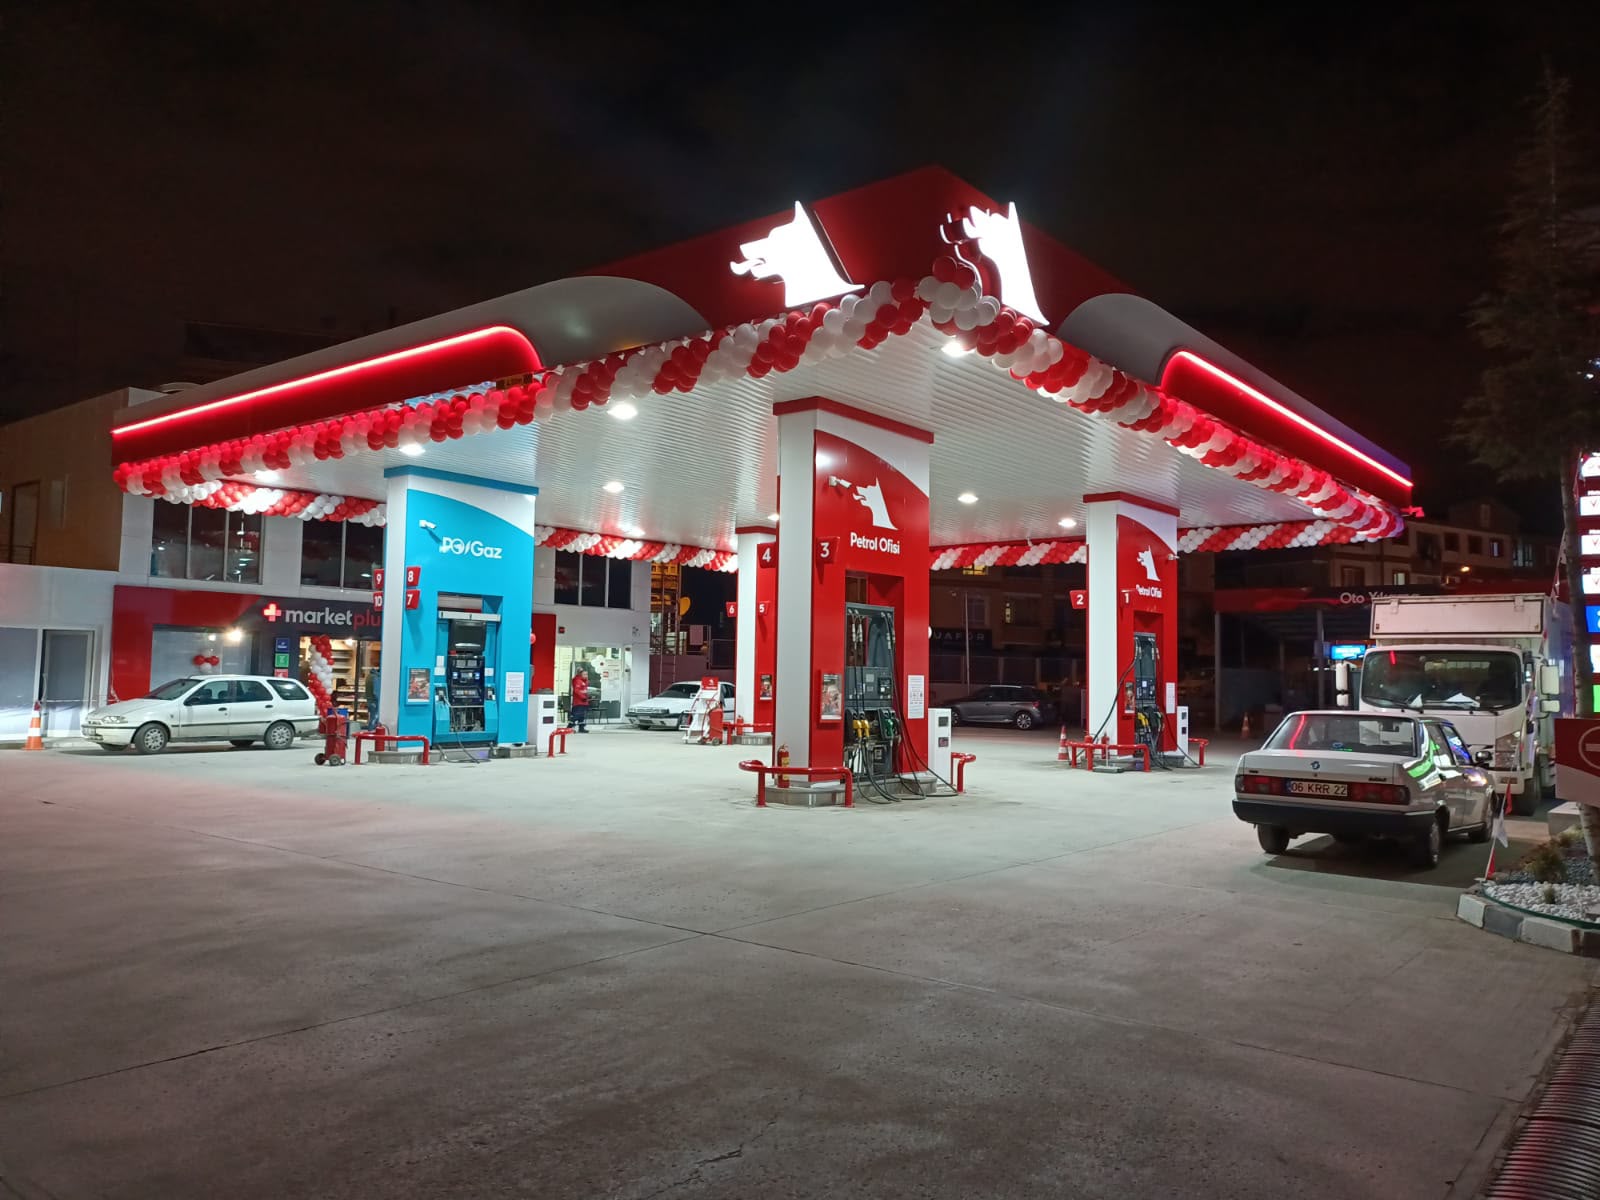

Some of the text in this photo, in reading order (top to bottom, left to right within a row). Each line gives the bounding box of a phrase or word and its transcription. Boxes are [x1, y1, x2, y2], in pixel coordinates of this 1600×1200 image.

[850, 532, 900, 555] Petrol Ofisi
[762, 547, 772, 562] 4
[820, 542, 830, 558] 3
[376, 573, 382, 585] 9
[407, 570, 414, 582] 8
[374, 595, 382, 607] 10
[406, 594, 413, 605] 7
[1076, 594, 1084, 605] 2
[1124, 592, 1129, 604] 1
[1340, 591, 1365, 604] Oto
[729, 605, 735, 614] 6
[759, 603, 764, 613] 5
[1291, 781, 1347, 795] 06 KRR 22
